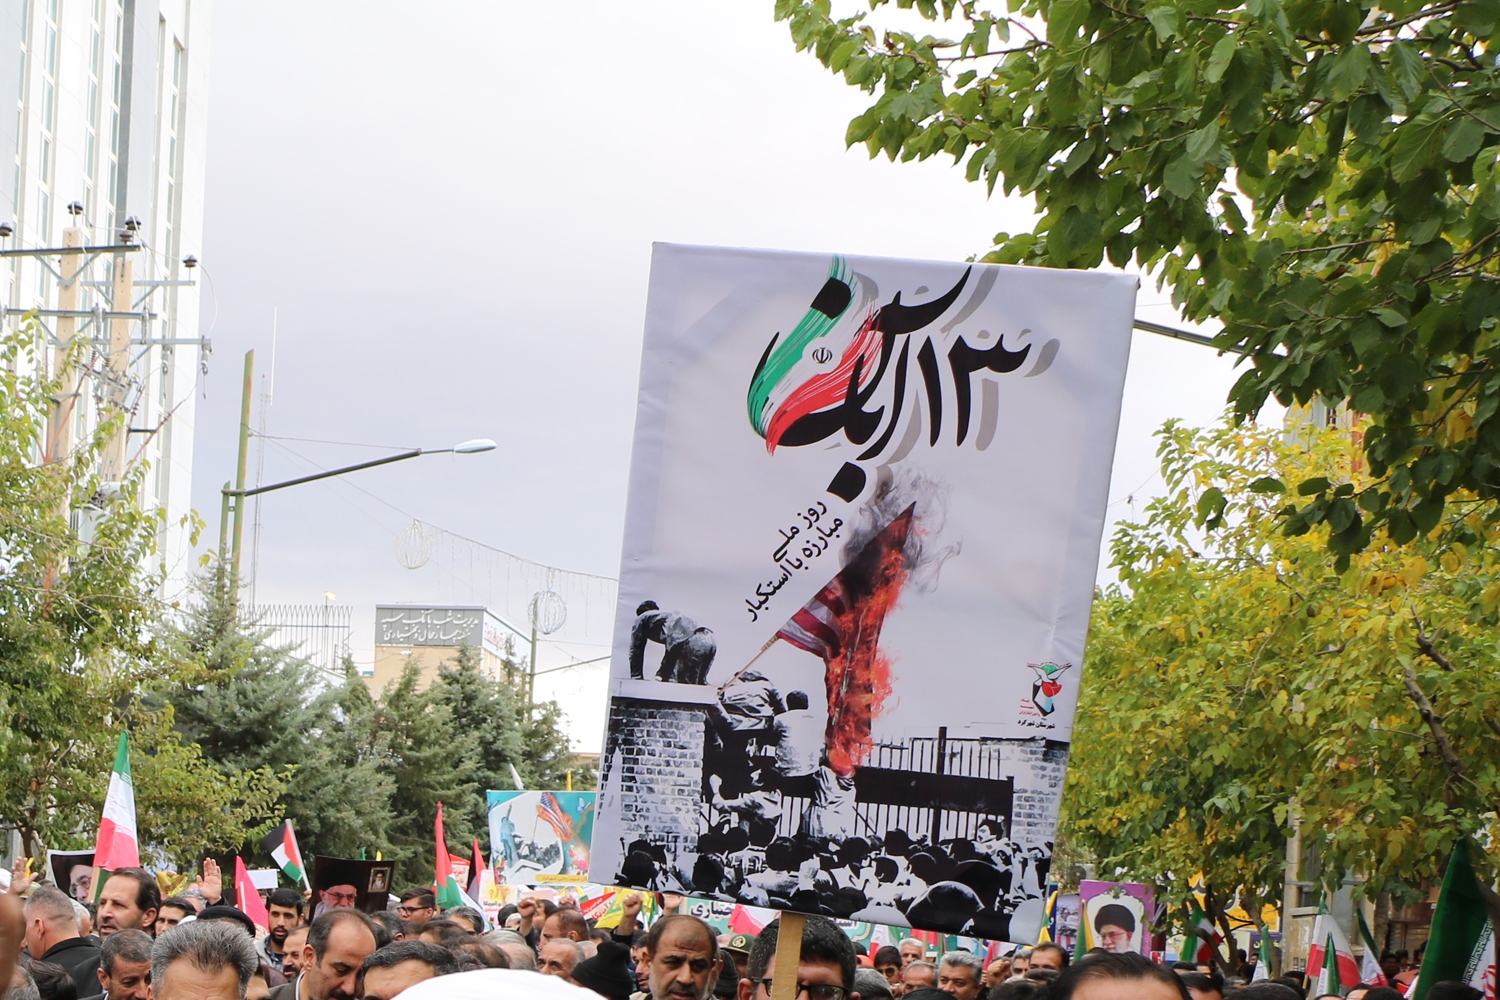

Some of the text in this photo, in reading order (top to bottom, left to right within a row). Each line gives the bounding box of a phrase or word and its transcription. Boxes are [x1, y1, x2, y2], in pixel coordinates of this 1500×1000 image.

[745, 518, 844, 622] مبارزه با استکبار
[773, 501, 827, 563] روز ملی
